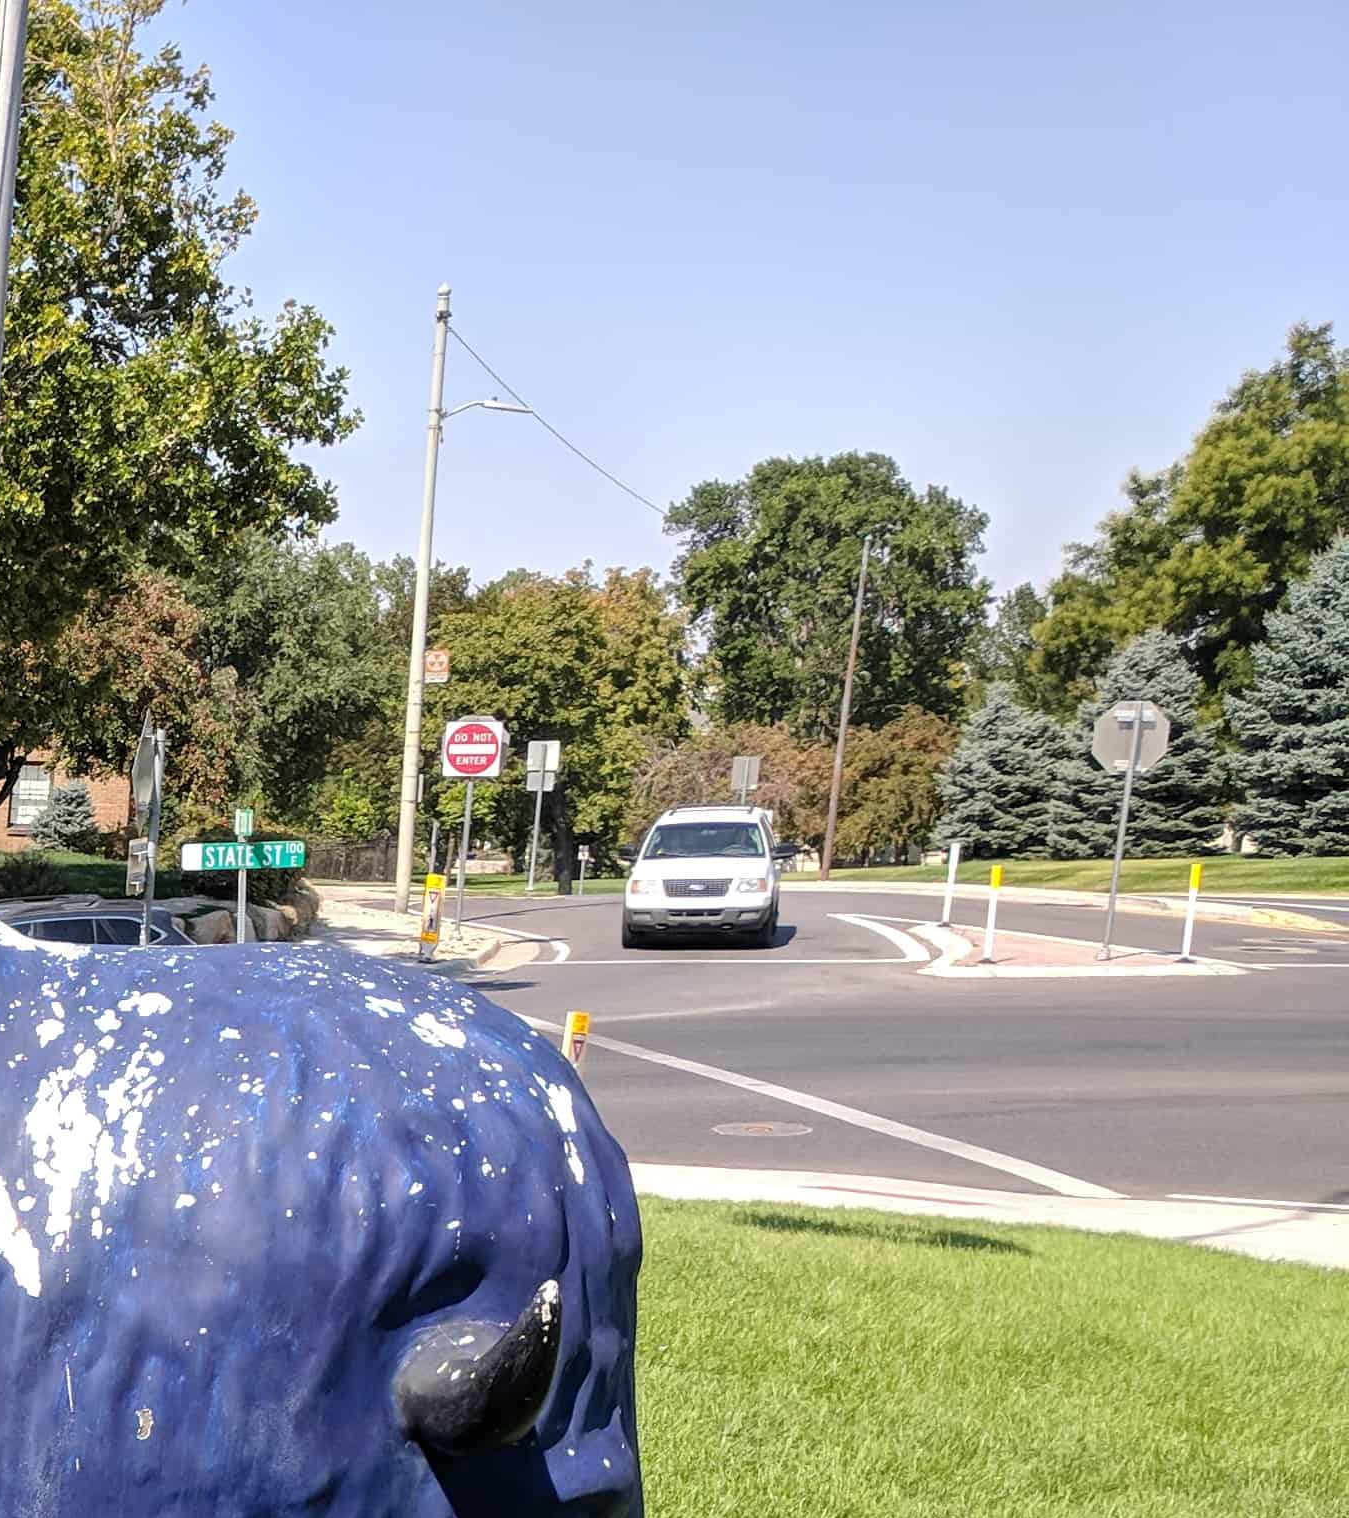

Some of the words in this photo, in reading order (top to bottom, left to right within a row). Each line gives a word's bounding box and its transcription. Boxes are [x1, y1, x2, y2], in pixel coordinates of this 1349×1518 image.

[454, 733, 468, 742] DO
[473, 732, 493, 742] NOT
[455, 756, 487, 765] ENTER
[205, 845, 255, 867] STATE
[262, 844, 285, 866] ST
[285, 842, 304, 854] 100
[290, 855, 298, 867] E
